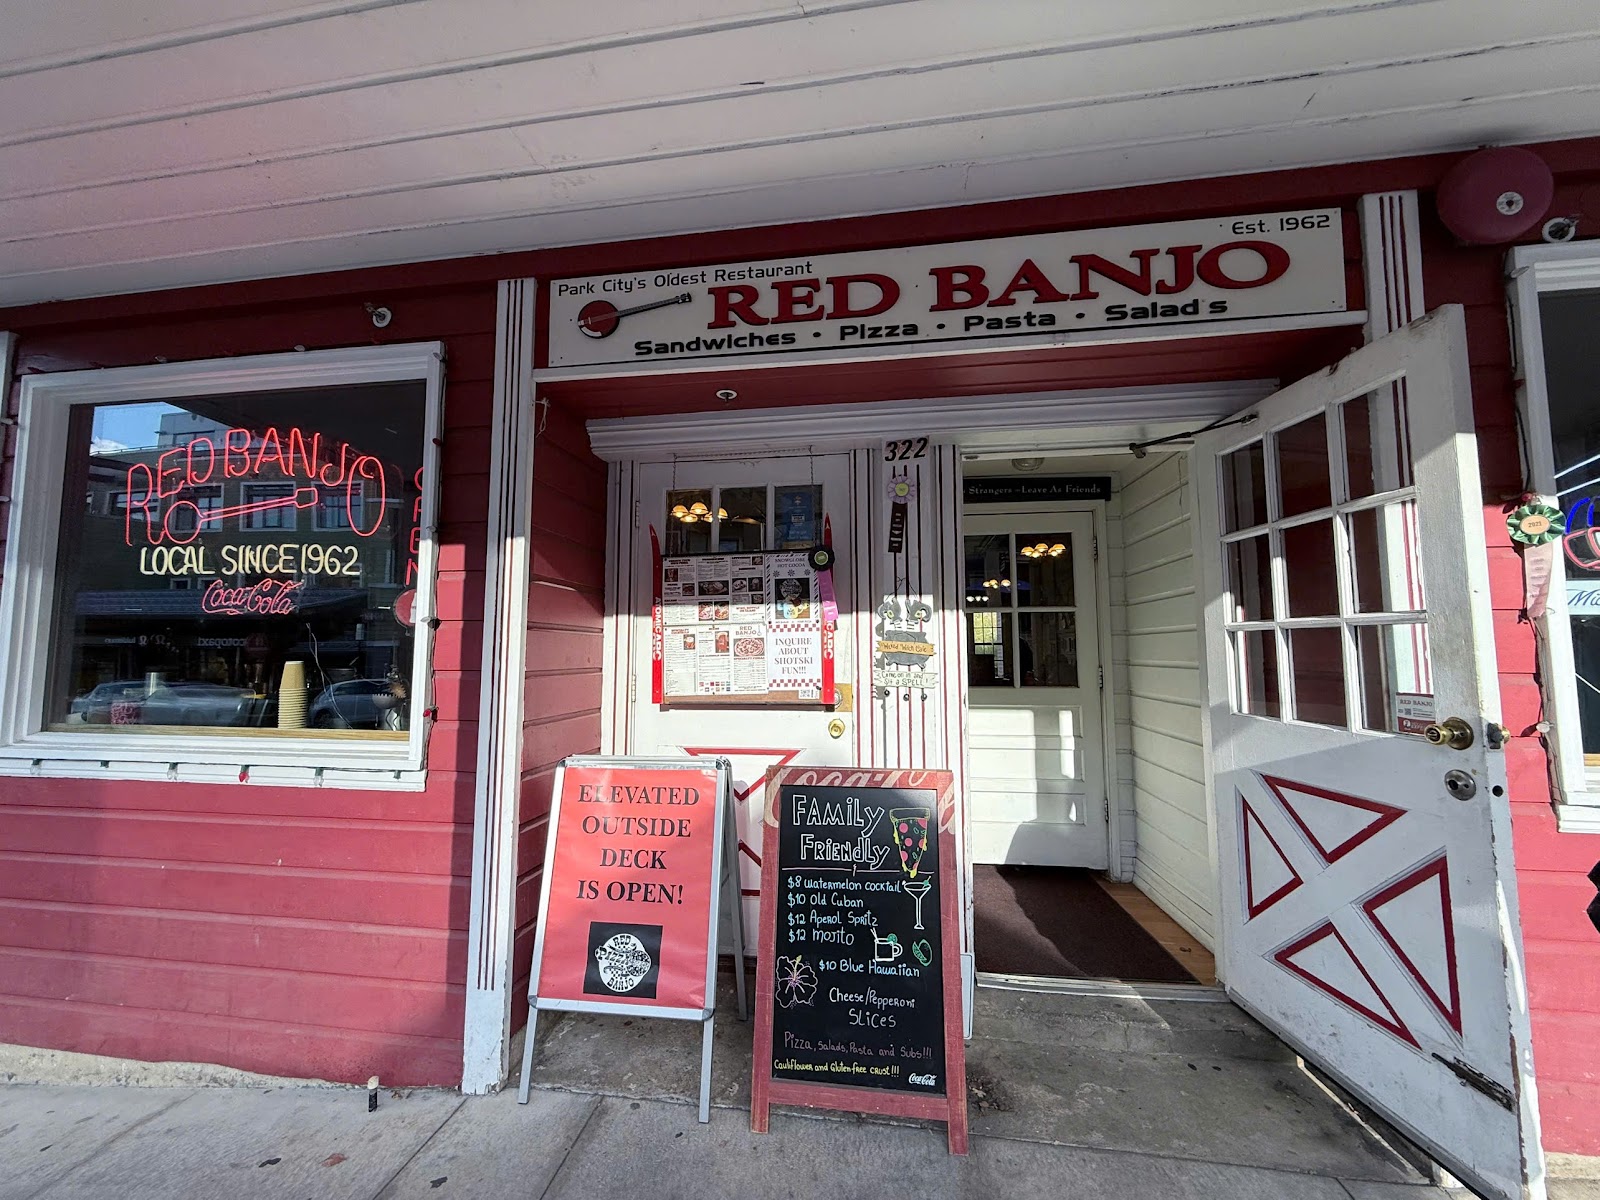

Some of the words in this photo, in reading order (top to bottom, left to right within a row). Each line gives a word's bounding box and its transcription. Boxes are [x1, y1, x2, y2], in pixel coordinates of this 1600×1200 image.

[1231, 218, 1271, 235] Est.
[1279, 213, 1331, 231] 1962
[558, 281, 595, 296] Park
[601, 276, 647, 293] City's
[654, 272, 707, 288] Oldest
[714, 260, 813, 282] Restaurant
[707, 272, 901, 330] RED
[929, 240, 1291, 313] BANJO
[634, 331, 797, 356] Sandwiches
[839, 322, 919, 341] Pizza
[964, 311, 1056, 332] Pasta
[884, 437, 928, 461] 322
[126, 437, 214, 547] RED
[224, 427, 386, 536] BANJO
[1050, 485, 1062, 493] As
[1065, 484, 1101, 493] Friends
[139, 545, 215, 576] LOCAL
[221, 544, 299, 574] SINCE
[300, 543, 362, 576] 1962
[202, 578, 304, 615] Coca-Cola
[775, 638, 813, 647] INQUIRE
[774, 657, 814, 665] SHOTSKI
[781, 667, 807, 675] FUN!!!
[578, 785, 700, 806] ELEVATED
[582, 815, 691, 837] OUTSIDE
[599, 848, 667, 869] DECK
[787, 875, 802, 889] $8
[576, 880, 600, 900] IS
[606, 881, 684, 905] OPEN!
[787, 891, 806, 908] $10
[810, 892, 828, 905] Old
[831, 892, 864, 907] Cuban
[787, 911, 806, 926] $12
[613, 935, 631, 946] RED
[788, 928, 807, 943] $12
[818, 958, 837, 971] $10
[839, 958, 865, 972] Blue
[868, 960, 920, 977] Hawaiian
[607, 977, 634, 990] BANJO
[878, 1047, 896, 1057] and
[814, 1062, 829, 1072] and
